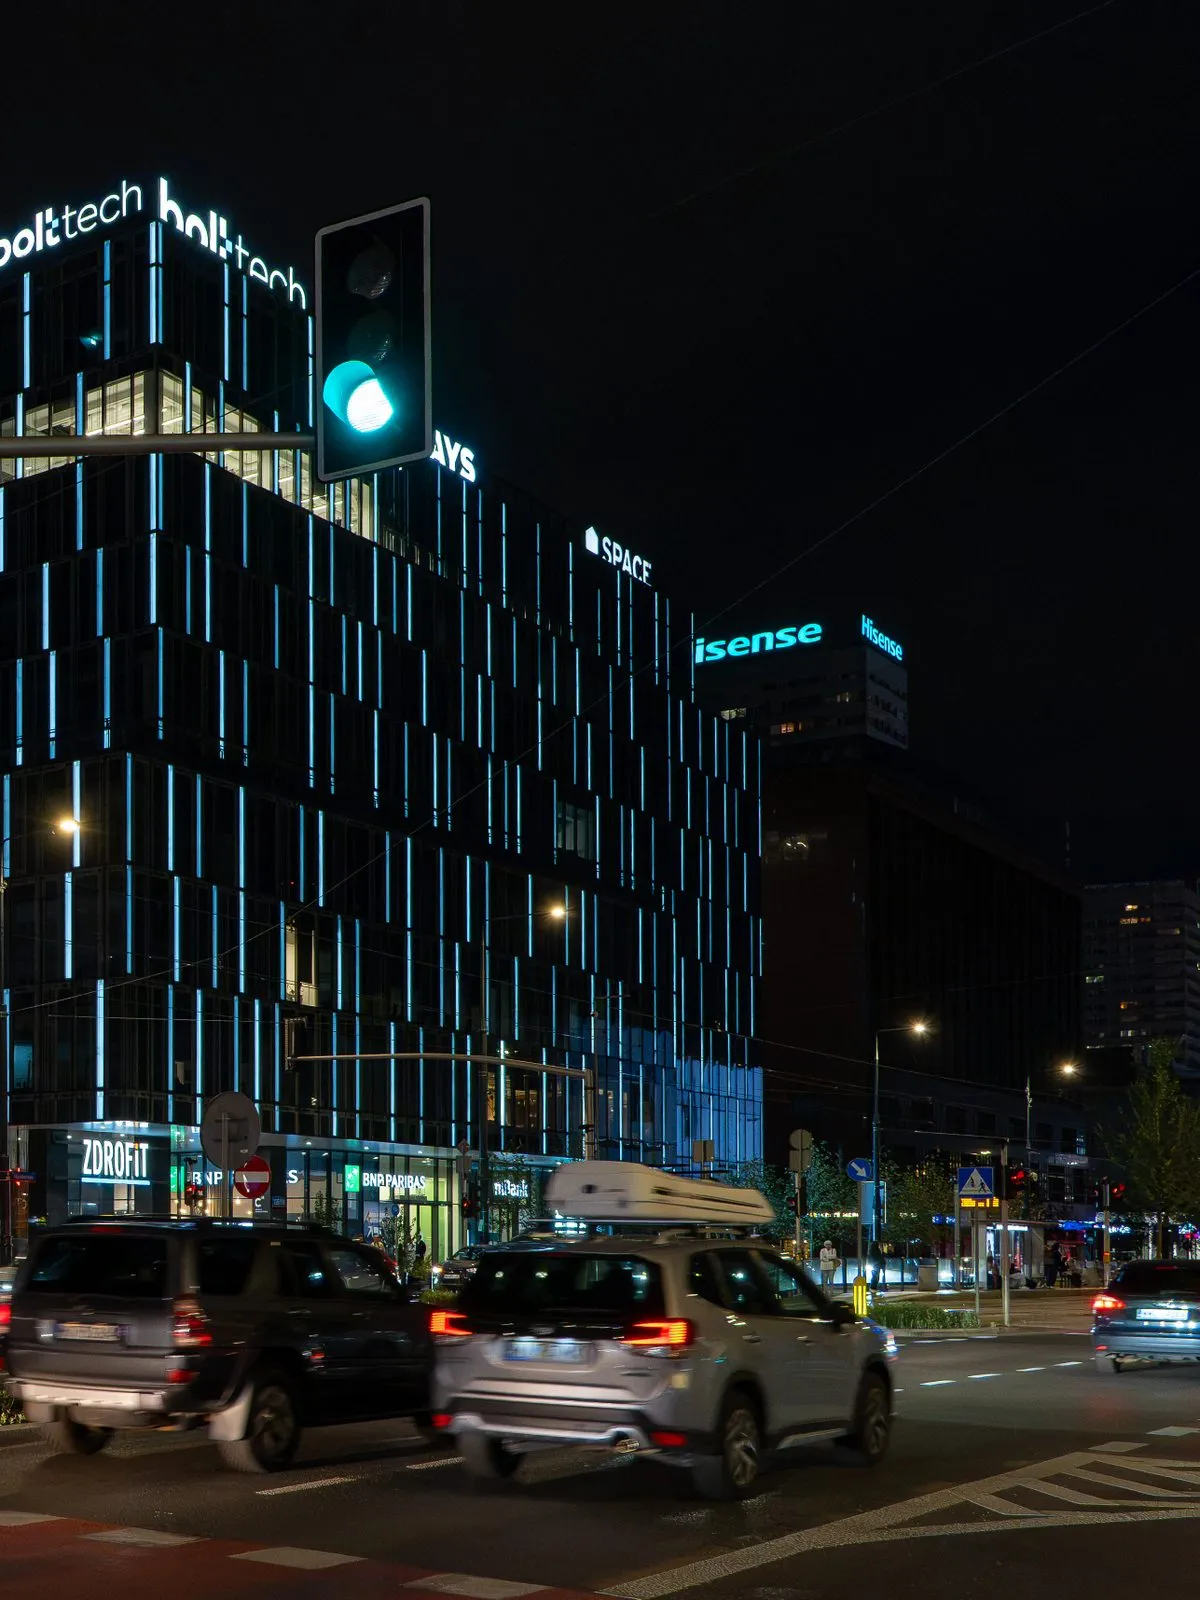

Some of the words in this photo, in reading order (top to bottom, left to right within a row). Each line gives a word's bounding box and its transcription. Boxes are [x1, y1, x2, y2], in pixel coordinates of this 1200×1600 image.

[430, 429, 476, 483] AYS
[602, 536, 652, 587] SPACE
[695, 622, 822, 664] isense
[861, 614, 903, 661] Hisense
[385, 1173, 427, 1190] PARIBAS
